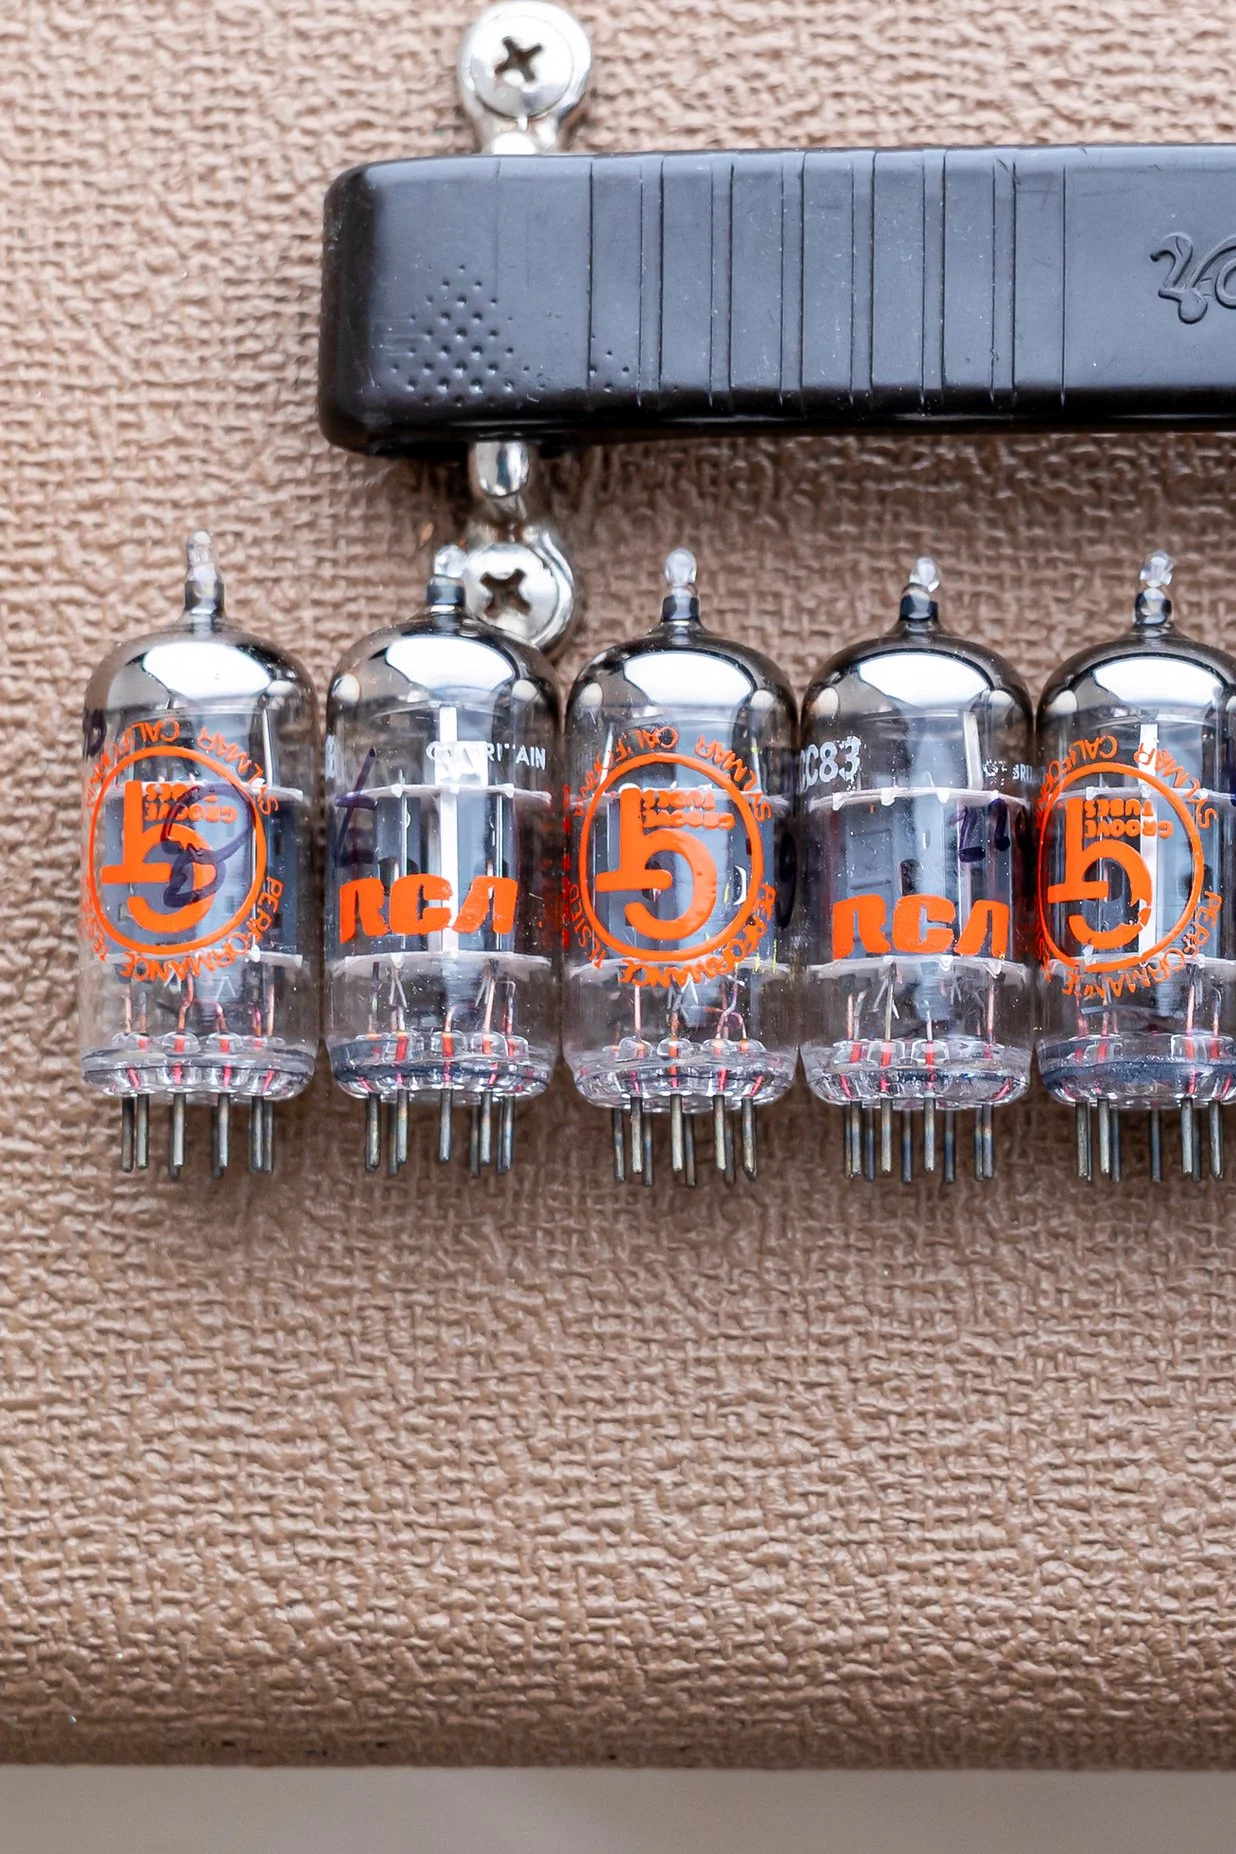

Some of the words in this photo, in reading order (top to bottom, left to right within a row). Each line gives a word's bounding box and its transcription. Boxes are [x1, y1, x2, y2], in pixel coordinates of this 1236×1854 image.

[1082, 798, 1153, 818] TUBES
[1134, 742, 1218, 829] SYLMAR
[1083, 819, 1174, 839] GROOVE
[119, 877, 284, 982] PERFORMANCE
[339, 873, 519, 944] RCA
[832, 894, 1010, 959] RCA
